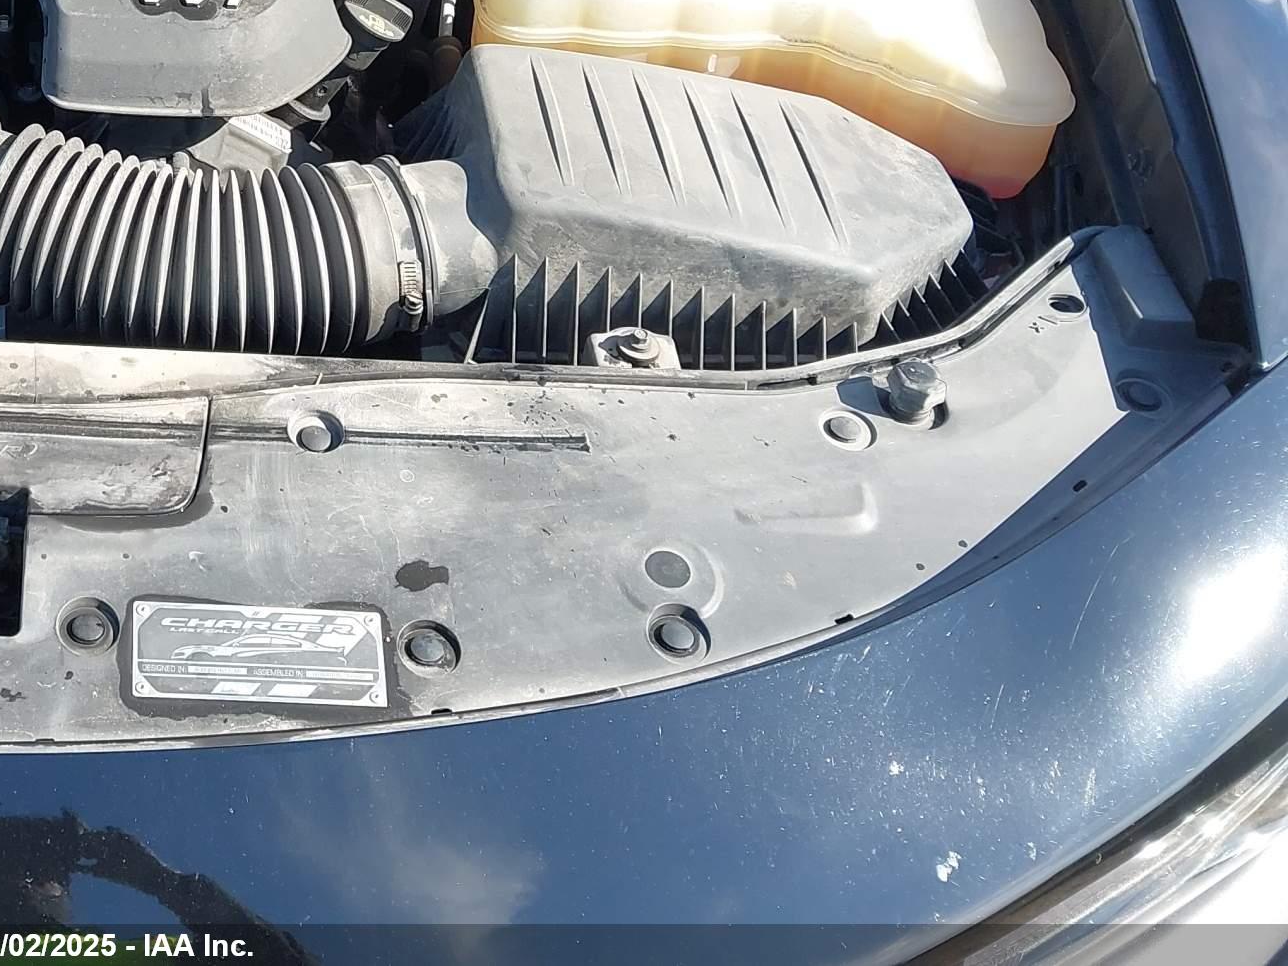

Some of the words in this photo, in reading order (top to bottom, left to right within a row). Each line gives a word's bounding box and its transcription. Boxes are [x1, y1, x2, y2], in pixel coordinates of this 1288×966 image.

[160, 617, 355, 634] CHARGER
[142, 664, 176, 673] DESIGNED
[252, 668, 296, 678] ASSEMBLED
